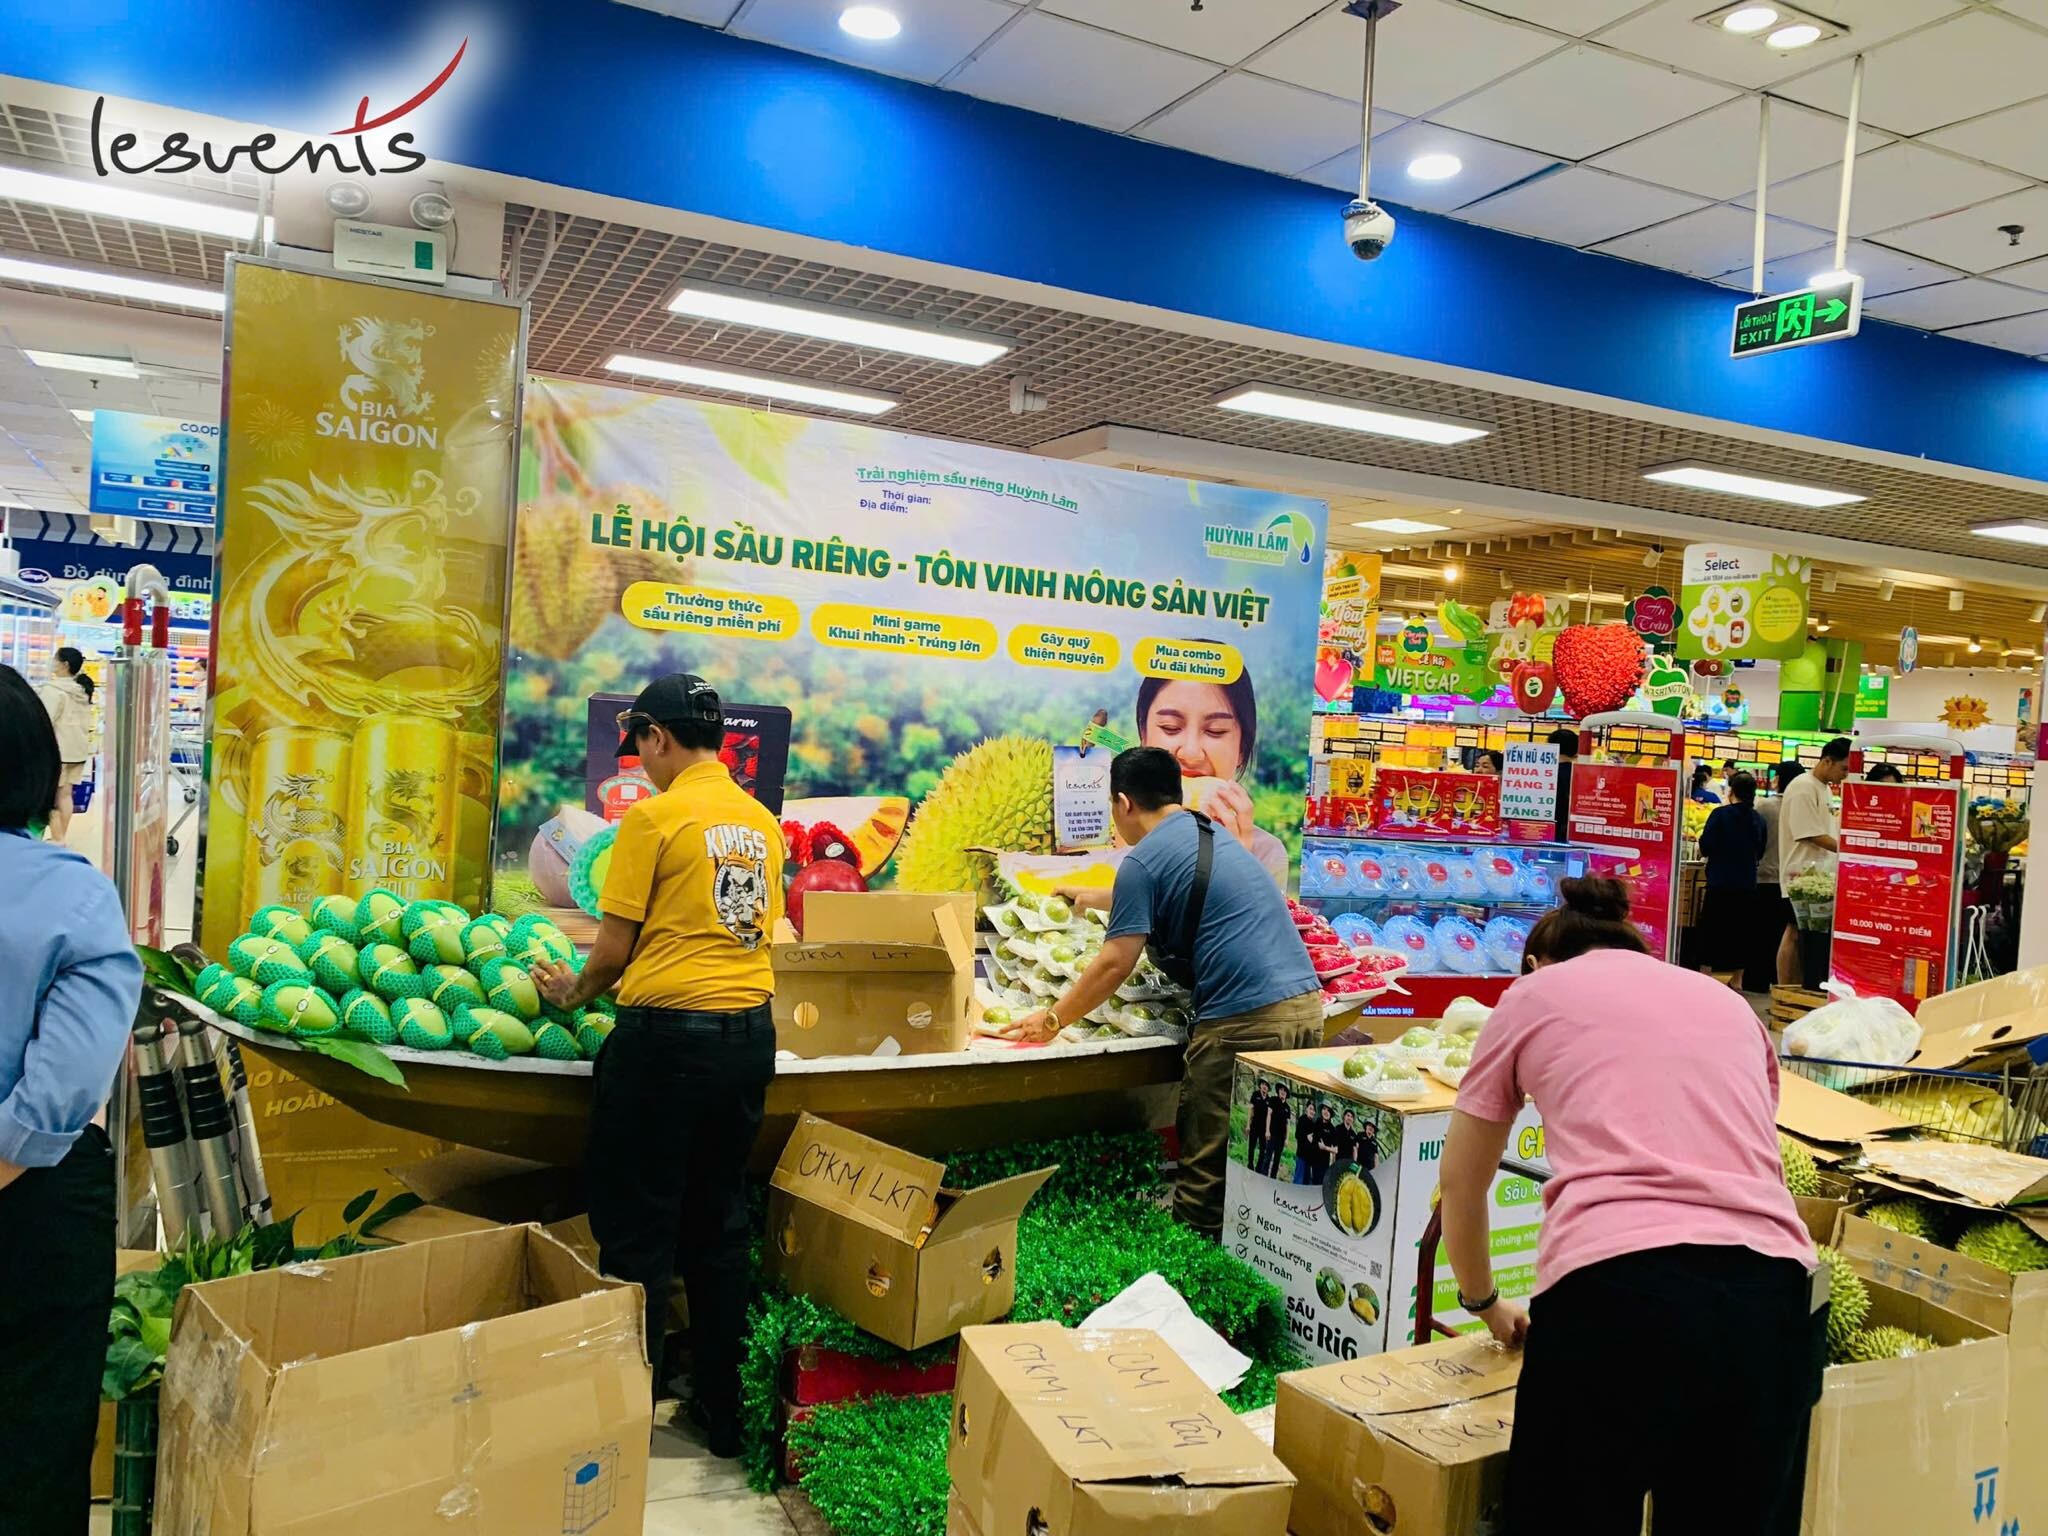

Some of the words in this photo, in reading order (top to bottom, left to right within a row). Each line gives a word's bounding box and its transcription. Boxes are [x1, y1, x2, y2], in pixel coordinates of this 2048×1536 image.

[1752, 311, 1777, 326] THOÁT
[1740, 328, 1772, 345] EXIT
[361, 401, 397, 419] BIA
[316, 411, 438, 449] SAIGON
[888, 469, 939, 483] nghiệm
[970, 476, 1004, 493] riêng
[1007, 482, 1048, 501] Huỳnh
[1052, 492, 1078, 510] Lâm
[907, 493, 931, 504] gian:
[860, 498, 877, 510] Địa
[880, 501, 908, 513] điểm:
[1205, 526, 1254, 547] HUỲNH
[1257, 531, 1288, 551] LÂM
[64, 562, 89, 578] Đồ
[591, 503, 633, 548] LỄ
[640, 515, 706, 563] HỘI
[712, 520, 784, 566] SẦU
[791, 535, 891, 578] RIÊNG
[915, 550, 977, 590] TÔN
[983, 563, 1058, 599] VINH
[1064, 569, 1146, 609] NÔNG
[1150, 579, 1206, 615] SẢN
[1212, 587, 1270, 628] VIỆT
[1704, 558, 1740, 571] Select
[665, 591, 723, 611] Thưởng
[728, 597, 763, 614] thức
[673, 609, 714, 627] riêng
[717, 613, 754, 630] miễn
[757, 617, 781, 634] phí
[872, 613, 901, 629] Mini
[904, 619, 941, 633] game
[829, 626, 860, 641] Khui
[863, 629, 906, 645] nhanh
[918, 634, 957, 652] Trúng
[959, 638, 981, 653] lớn
[1040, 632, 1064, 648] Gây
[1067, 635, 1090, 649] quỹ
[1024, 645, 1056, 660] thiện
[1058, 650, 1105, 666] nguyện
[1155, 644, 1180, 657] Mua
[1183, 647, 1222, 661] combo
[1150, 657, 1166, 671] Ưu
[1169, 660, 1187, 673] đãi
[1189, 661, 1226, 678] khủng
[1386, 667, 1460, 692] VIETGAP
[1645, 684, 1692, 697] WASHINGTON
[723, 716, 758, 728] arm
[1506, 744, 1523, 763] YẾN
[1540, 752, 1558, 765] 45%
[1507, 767, 1538, 777] MUA
[1544, 769, 1553, 777] 5
[1504, 779, 1543, 790] TẶNG
[1502, 794, 1533, 804] MUA
[1538, 796, 1554, 805] 10
[1503, 807, 1539, 819] TẶNG
[1544, 810, 1553, 818] 3
[382, 840, 415, 856] BIA
[704, 824, 768, 860] KINGS
[349, 857, 447, 883] SAIGON
[1848, 918, 1873, 929] 10.000
[1909, 926, 1932, 937] ĐIỂM
[871, 950, 913, 961] LKT
[800, 1143, 866, 1196] CTKM
[869, 1172, 929, 1212] LKT
[1256, 1214, 1282, 1235] Ngon
[1254, 1234, 1278, 1255] Chất
[1279, 1247, 1313, 1274] Lượng
[1252, 1255, 1266, 1269] An
[1269, 1262, 1293, 1281] Toàn
[1317, 1322, 1358, 1361] Ri6
[1004, 1342, 1069, 1394] CTKM
[1056, 1414, 1114, 1451] LKT
